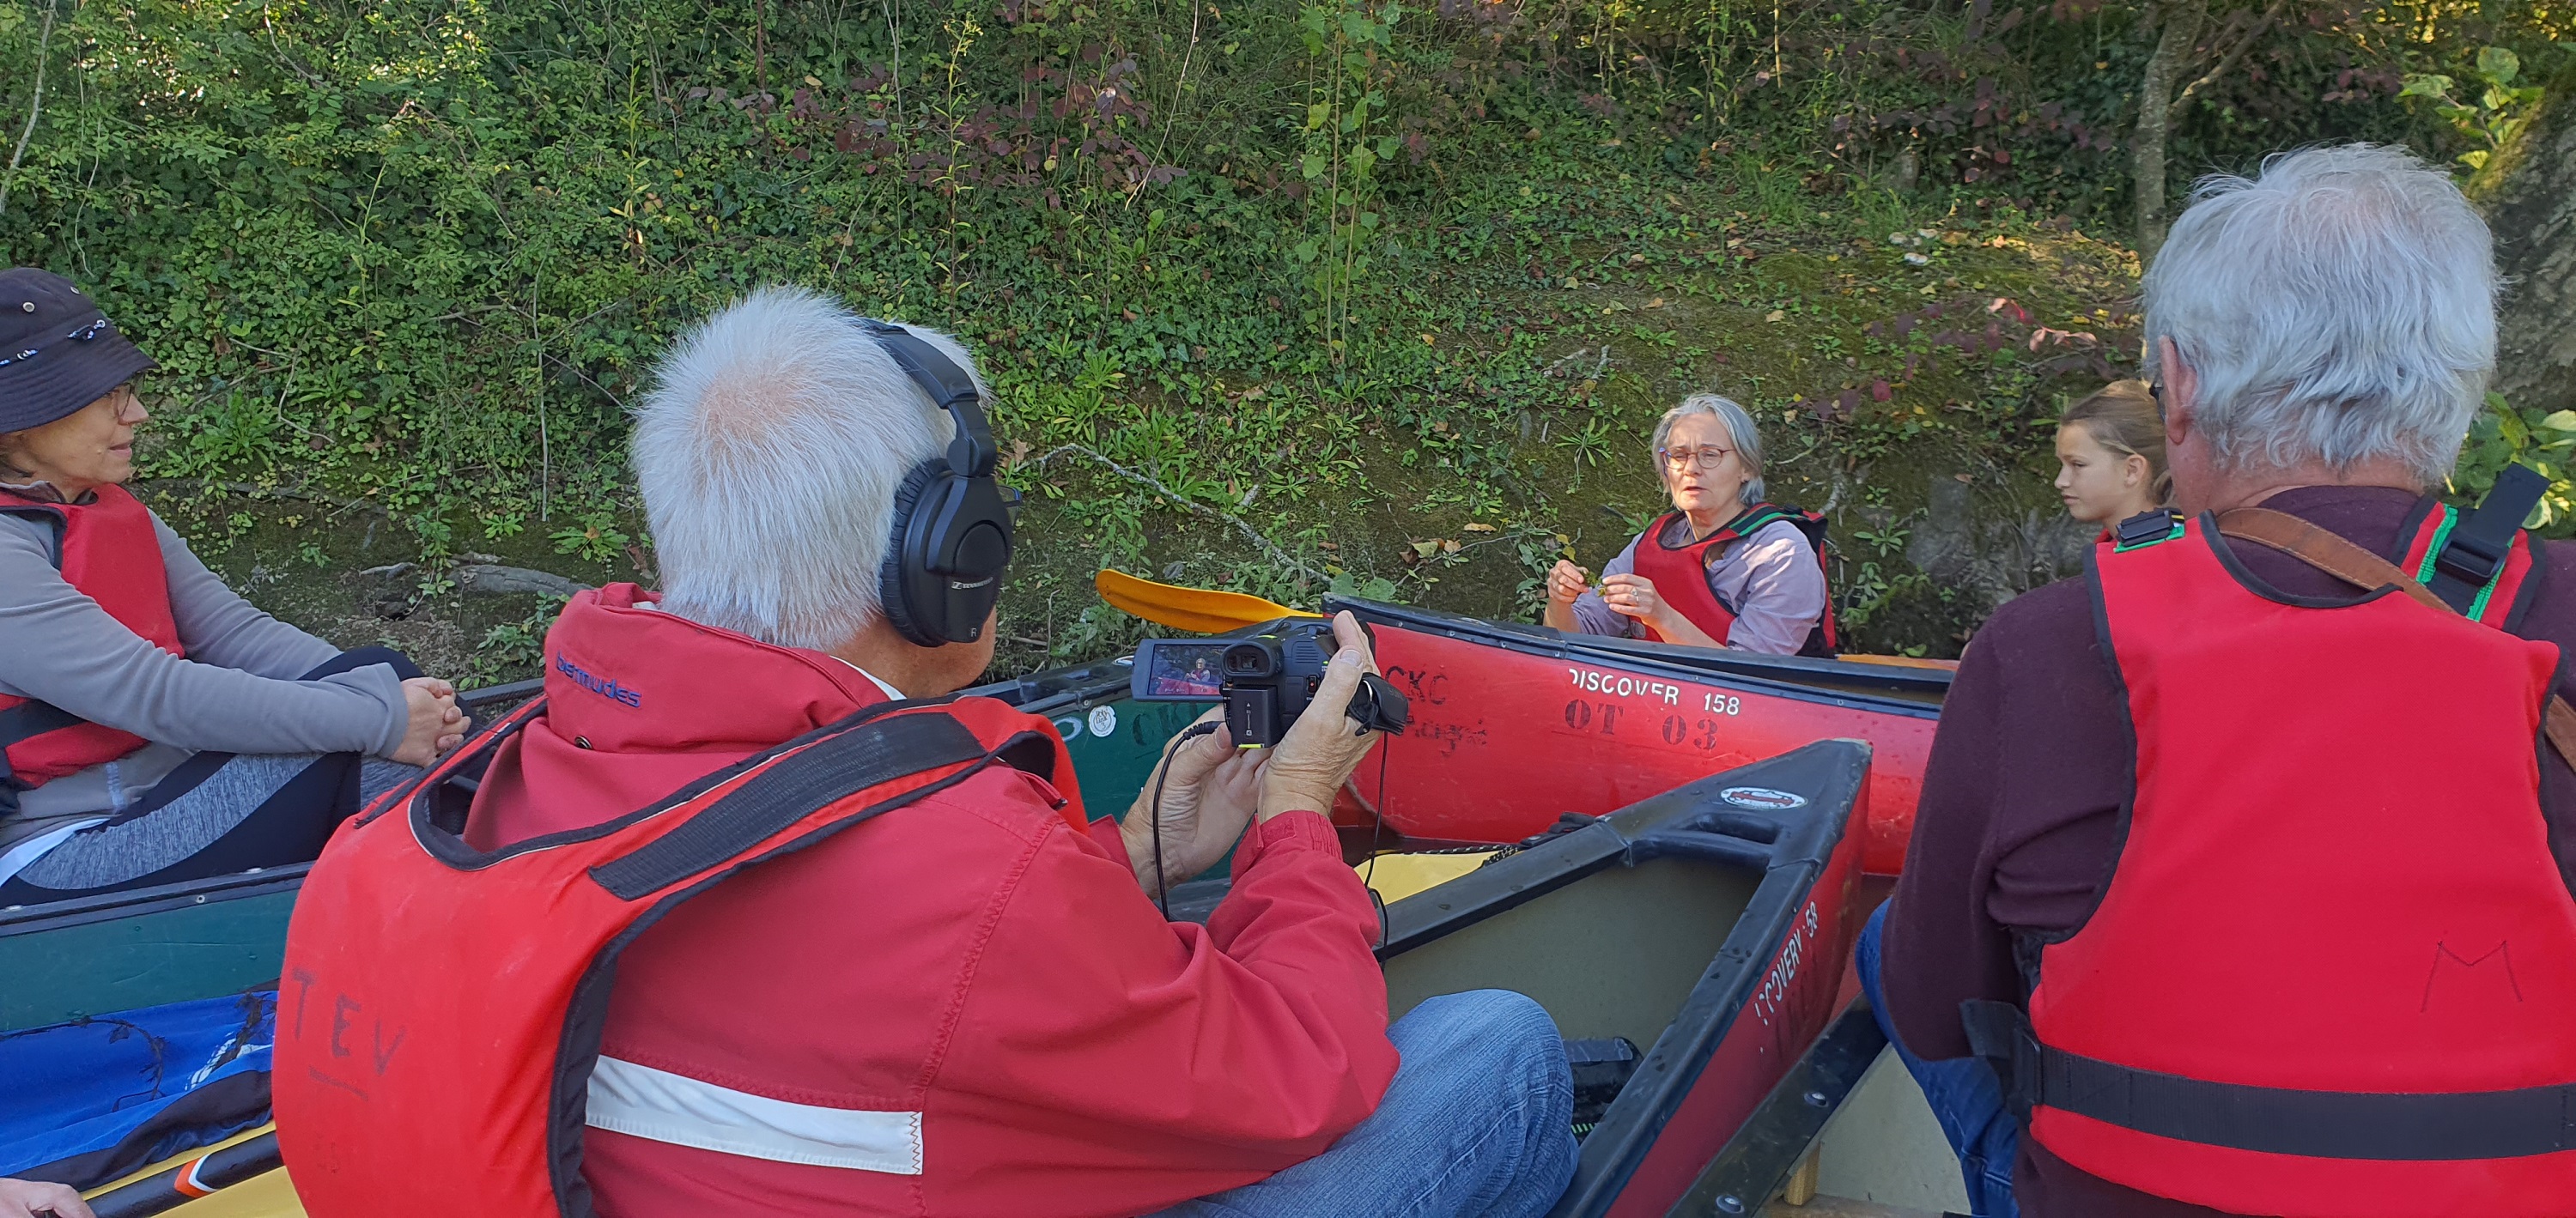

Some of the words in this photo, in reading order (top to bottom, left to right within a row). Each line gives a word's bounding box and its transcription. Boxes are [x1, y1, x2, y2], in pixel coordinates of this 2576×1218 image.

[556, 650, 642, 708] bermudes
[1704, 692, 1741, 716] 158
[1564, 699, 1624, 736] OT
[1662, 714, 1719, 751] 03
[1802, 900, 1818, 937] 58
[2420, 940, 2523, 1013] M
[293, 967, 407, 1076] TEV
